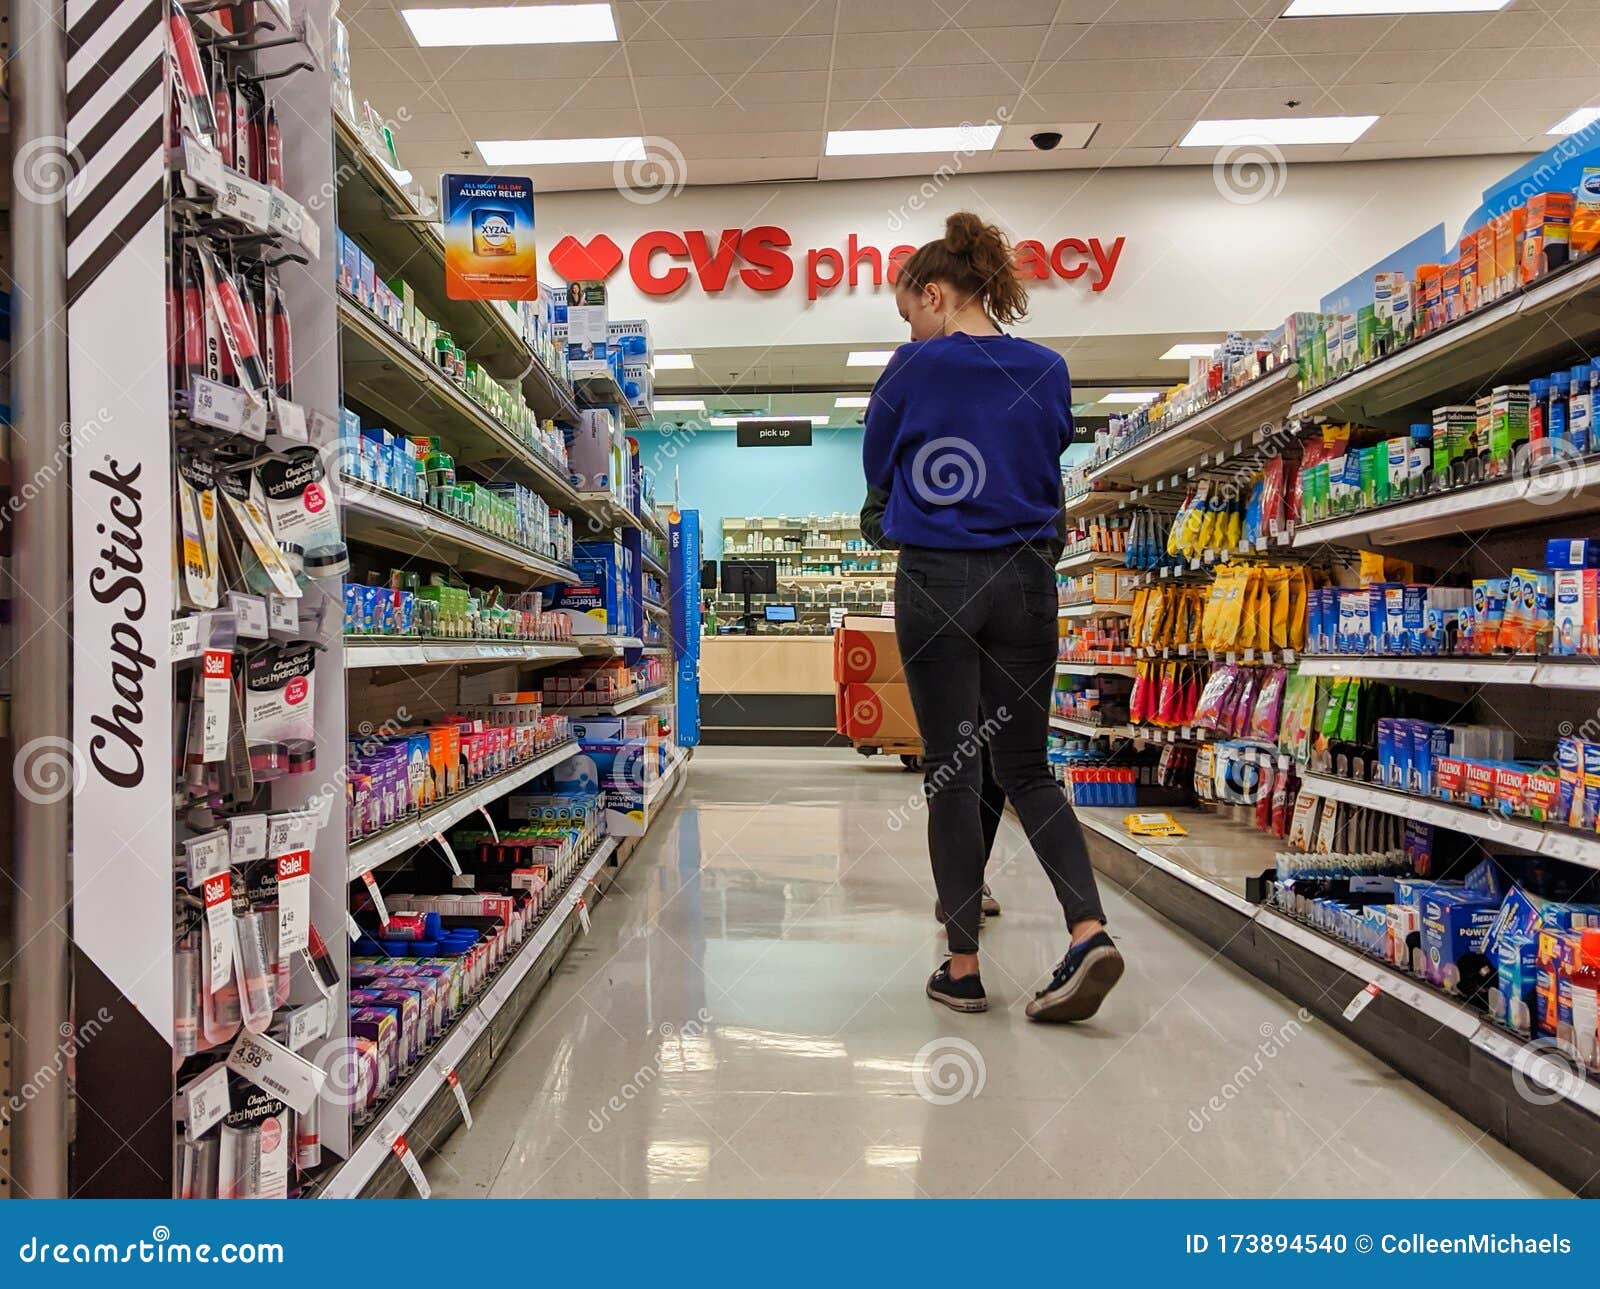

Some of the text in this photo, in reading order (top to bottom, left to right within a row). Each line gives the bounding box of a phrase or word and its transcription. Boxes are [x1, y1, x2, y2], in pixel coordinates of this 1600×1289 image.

[460, 189, 527, 199] ALLERGY RELIEF
[482, 225, 511, 234] XYZAL
[628, 226, 1125, 301] CVS phaacy
[760, 428, 790, 438] pick up
[285, 460, 316, 479] ChapStick
[268, 483, 286, 496] total
[672, 531, 680, 548] Kids
[205, 655, 225, 674] Sale!
[273, 654, 309, 672] ChapStick
[252, 675, 270, 687] total
[1437, 758, 1461, 776] TYLENOL
[1466, 763, 1492, 782] TYLENOL
[1496, 768, 1523, 788] TYLENOL
[1527, 774, 1556, 794] TYLENOL
[280, 855, 302, 876] Sale!
[206, 879, 225, 902] Sale!
[236, 1047, 262, 1068] 4.99
[227, 1101, 282, 1123] total hydration
